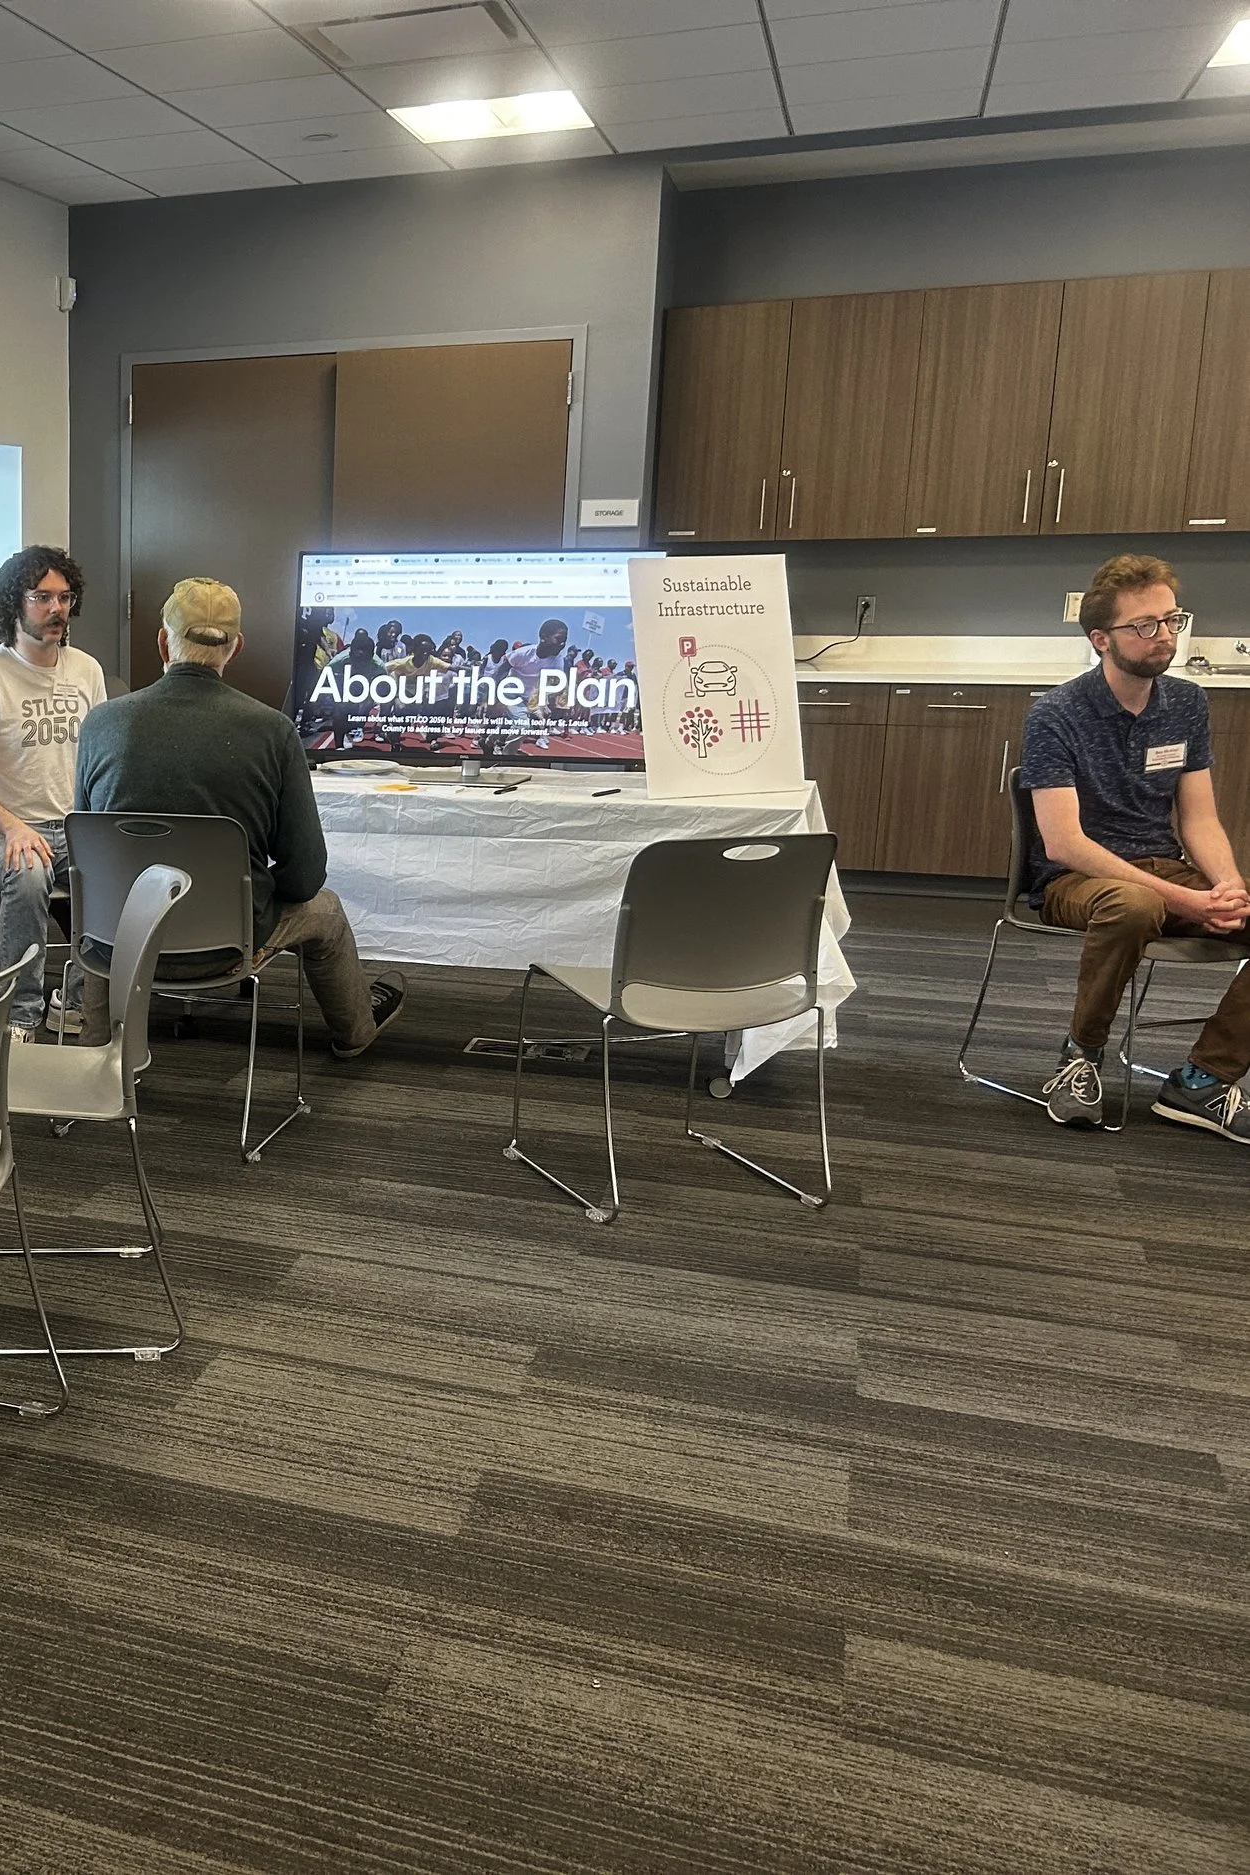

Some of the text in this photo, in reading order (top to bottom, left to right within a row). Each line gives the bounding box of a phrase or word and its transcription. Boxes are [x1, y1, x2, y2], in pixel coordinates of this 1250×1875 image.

[663, 575, 751, 592] Sustainable
[658, 601, 765, 616] Infrastructure
[309, 665, 636, 708] About the Plan
[22, 698, 79, 718] STLCO
[21, 716, 81, 747] 2050
[382, 725, 406, 733] County
[452, 726, 463, 734] key
